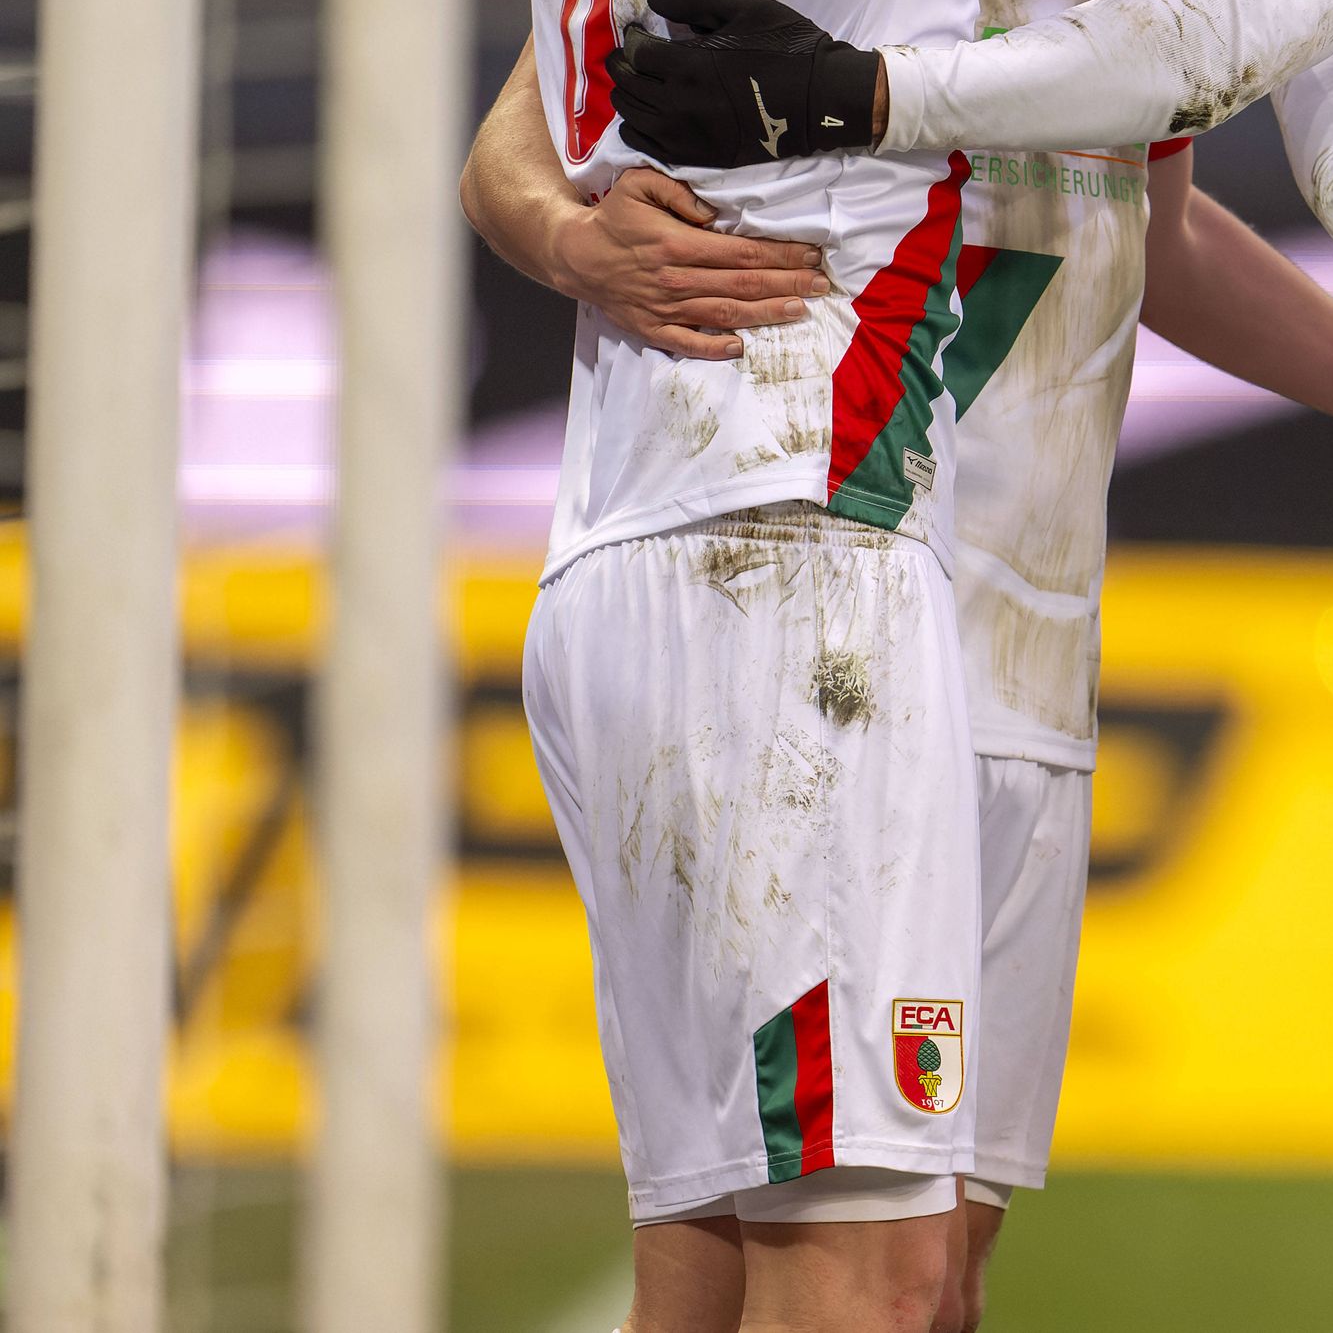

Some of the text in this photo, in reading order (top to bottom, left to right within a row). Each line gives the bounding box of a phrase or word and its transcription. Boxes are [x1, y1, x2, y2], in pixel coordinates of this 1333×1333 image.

[820, 115, 845, 128] 4
[901, 1006, 955, 1031] FCA
[921, 1098, 944, 1108] 1907
